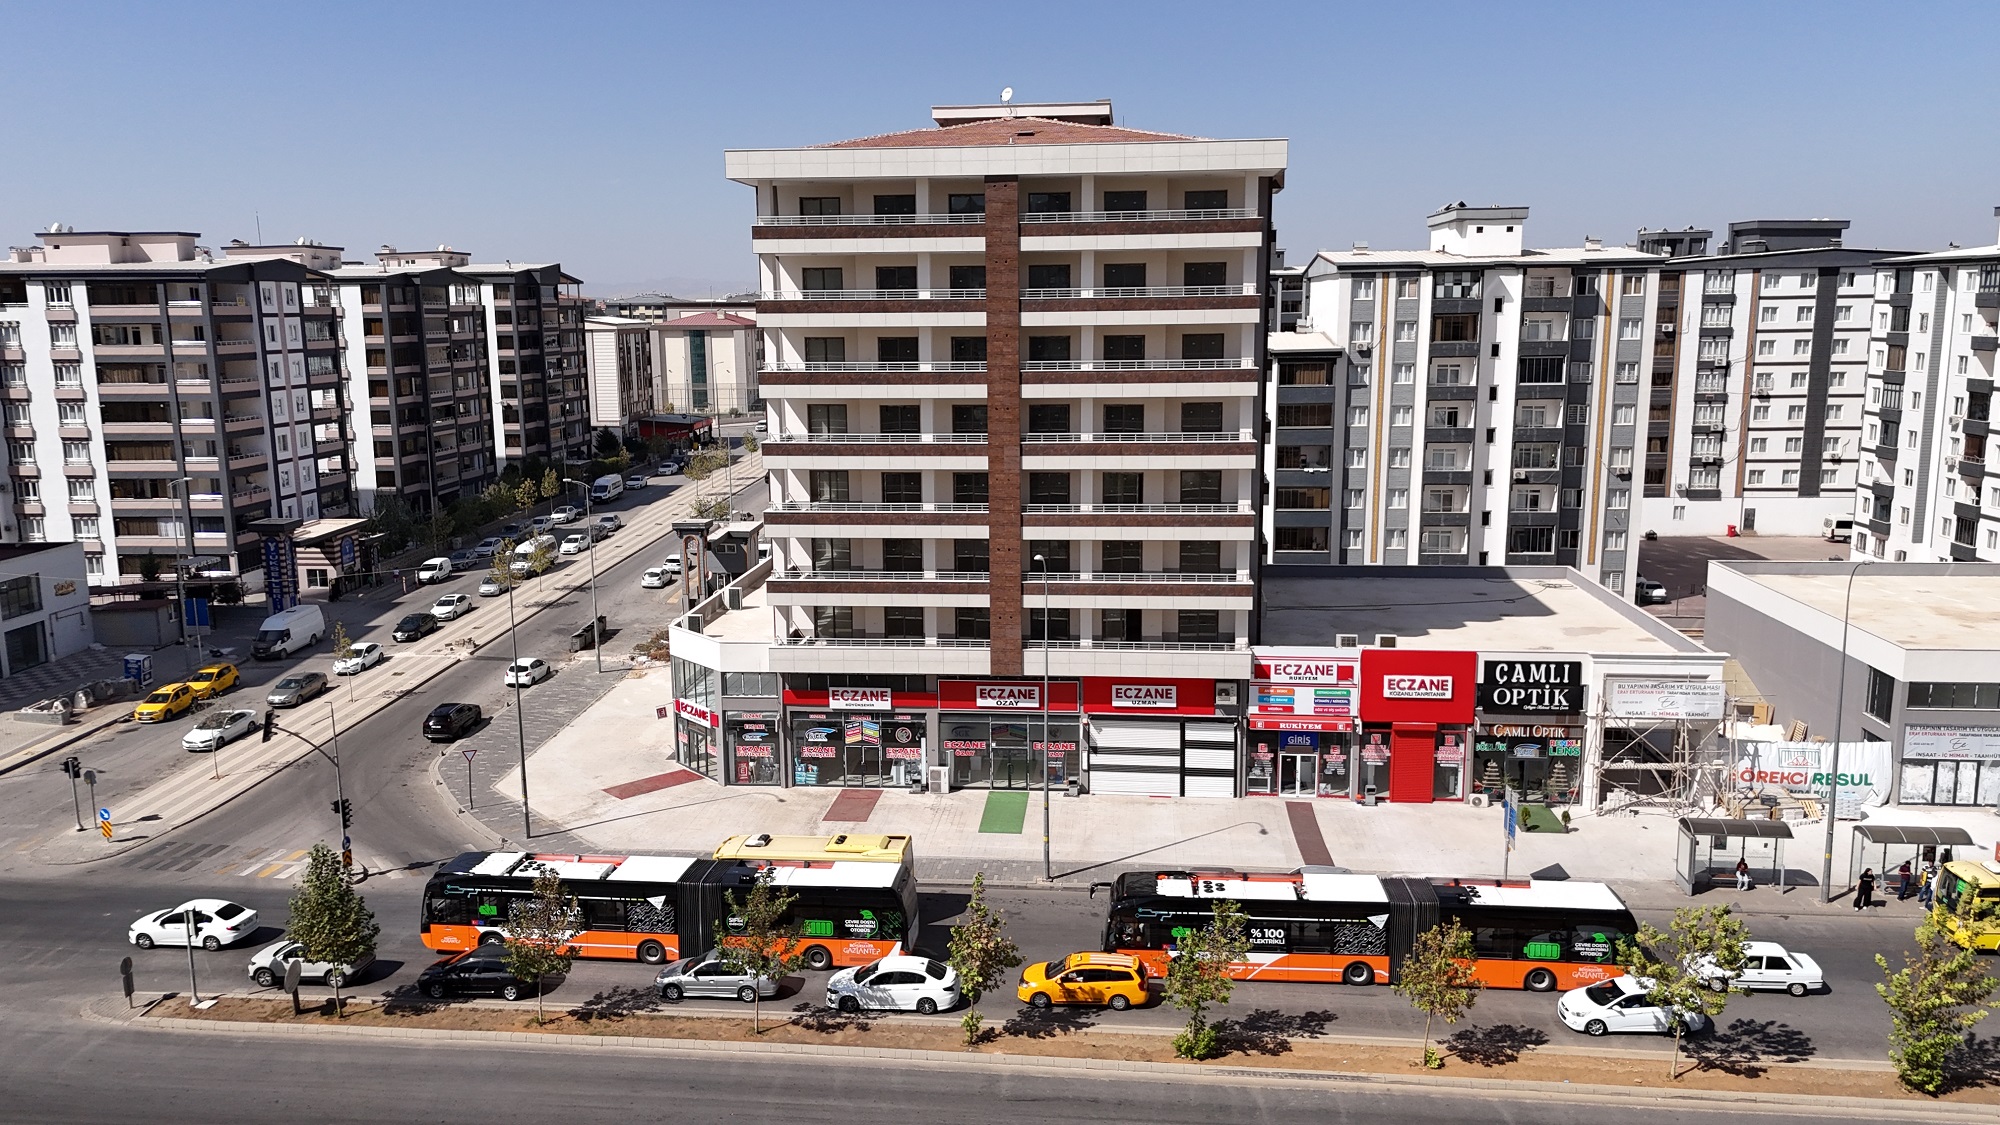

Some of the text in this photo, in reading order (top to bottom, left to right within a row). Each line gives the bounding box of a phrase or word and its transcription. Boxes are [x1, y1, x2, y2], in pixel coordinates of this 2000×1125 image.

[1274, 664, 1334, 676] ECZANE
[1495, 663, 1570, 684] ÇAMLI
[1388, 678, 1449, 691] ECZANE
[832, 690, 888, 702] ECZANE
[979, 688, 1036, 700] ECZANE
[1115, 688, 1173, 699] ECZANE
[1493, 684, 1570, 706] OPTİK
[680, 702, 709, 721] ECZANE
[1493, 724, 1530, 738] ÇAMLI
[1532, 725, 1565, 738] OPTİK
[944, 741, 986, 749] ECZANE
[1287, 734, 1311, 745] GİRİŞ
[1032, 742, 1076, 751] ECZANE
[1549, 747, 1580, 756] LENS
[1812, 772, 1874, 786] RESUL
[1250, 928, 1285, 938] % 100
